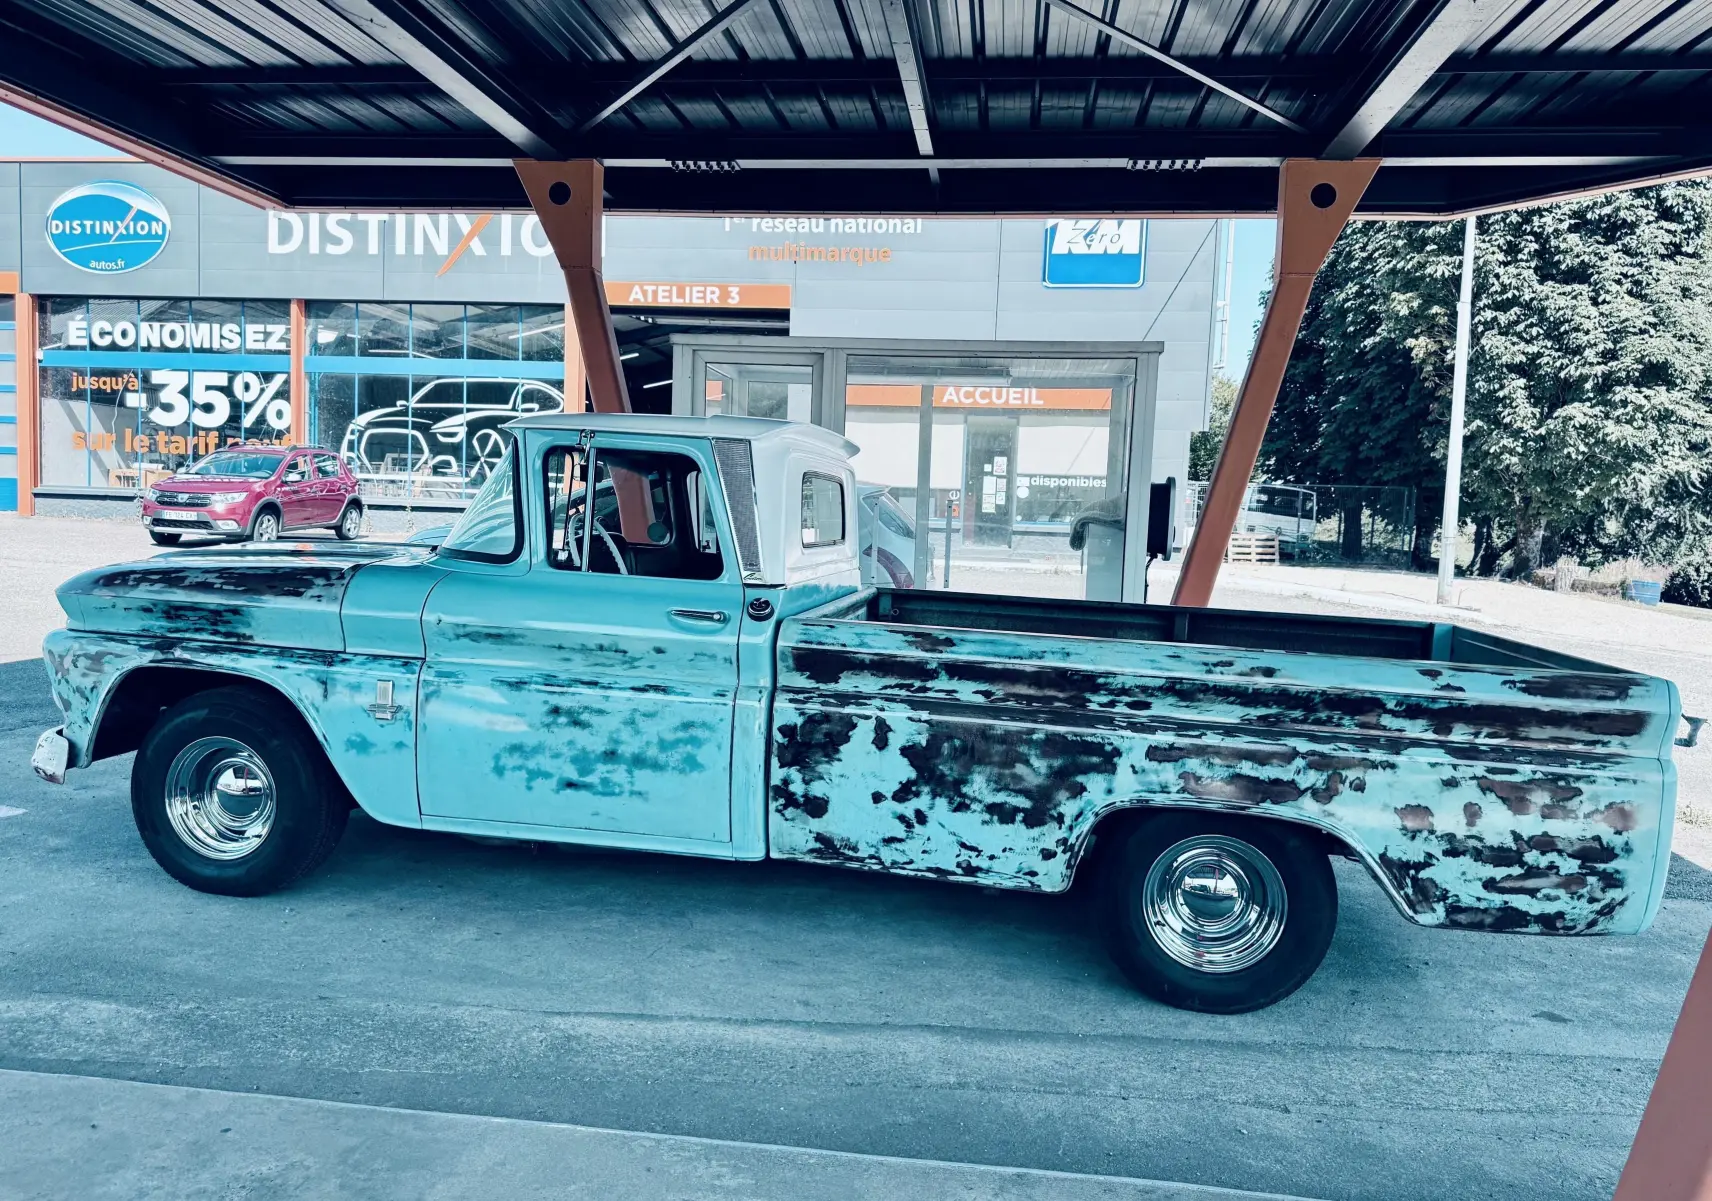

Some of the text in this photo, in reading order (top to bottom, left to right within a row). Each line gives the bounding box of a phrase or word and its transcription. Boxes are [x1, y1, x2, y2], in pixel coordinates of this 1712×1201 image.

[50, 212, 163, 240] DISTINXION
[830, 218, 922, 234] national
[266, 212, 606, 268] DISTINXIO
[89, 257, 125, 270] autos.fr
[748, 241, 892, 266] multimarque
[628, 285, 741, 304] ATELIER 3
[67, 315, 288, 350] ÉCONOMISEZ
[942, 386, 1044, 405] ACCUEIL
[71, 431, 116, 451] sur
[124, 428, 150, 453] le
[156, 430, 220, 455] tarif
[1030, 475, 1107, 488] disponibles
